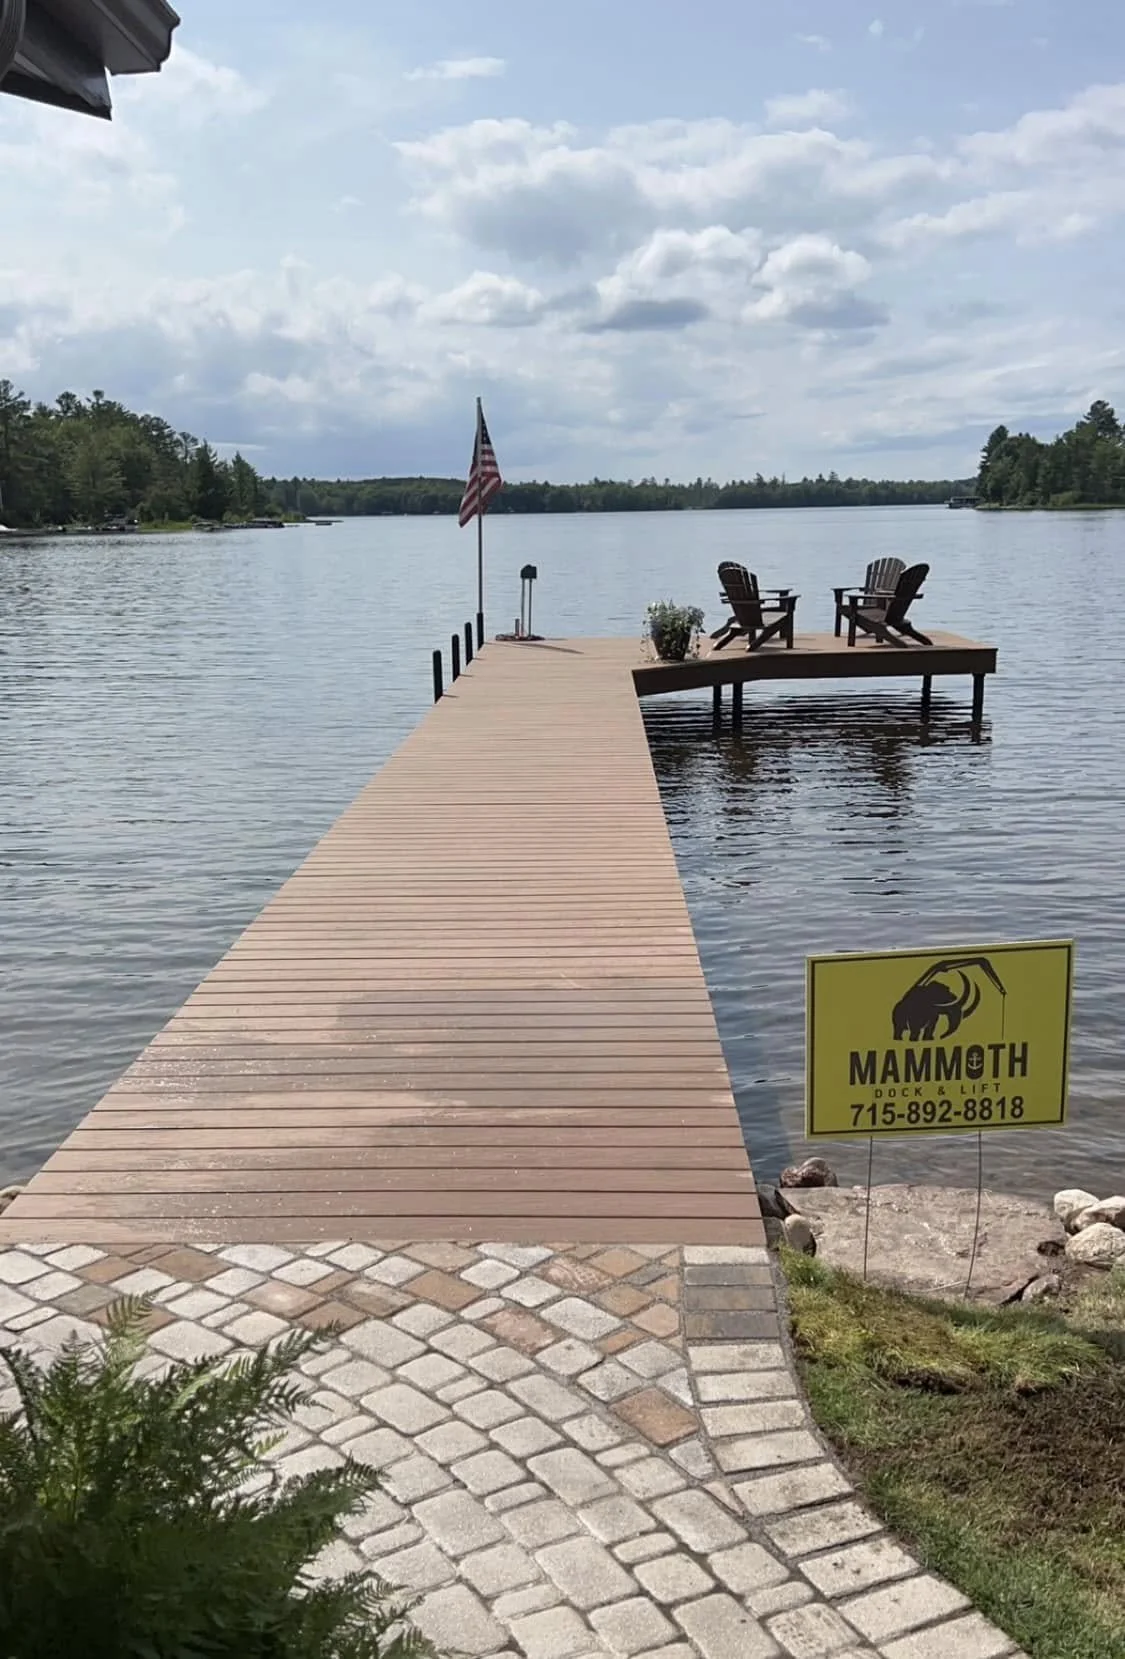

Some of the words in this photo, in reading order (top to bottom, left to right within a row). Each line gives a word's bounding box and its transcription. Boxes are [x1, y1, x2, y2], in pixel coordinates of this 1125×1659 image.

[850, 1042, 1028, 1085] MAMMOTH
[874, 1086, 923, 1098] DOCK
[937, 1085, 946, 1096] &
[960, 1083, 1001, 1095] LIFT
[850, 1096, 1024, 1127] 715-892-8818
